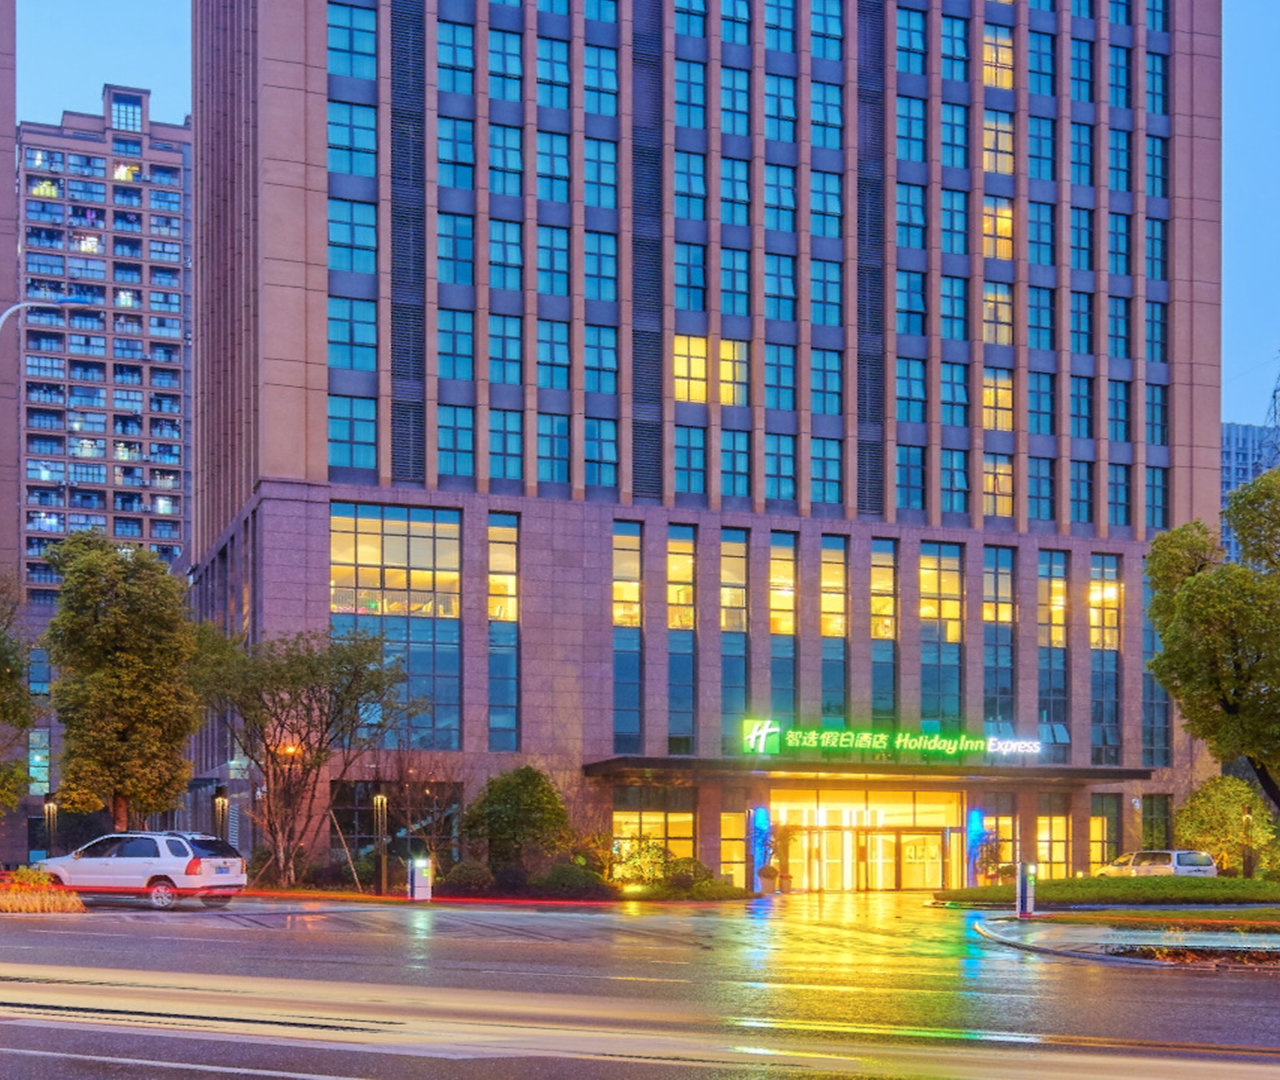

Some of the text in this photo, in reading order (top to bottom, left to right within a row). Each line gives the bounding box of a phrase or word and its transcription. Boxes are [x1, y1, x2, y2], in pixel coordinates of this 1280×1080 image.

[785, 730, 1041, 754] 智选假日酒店 Holiday Inn Express
